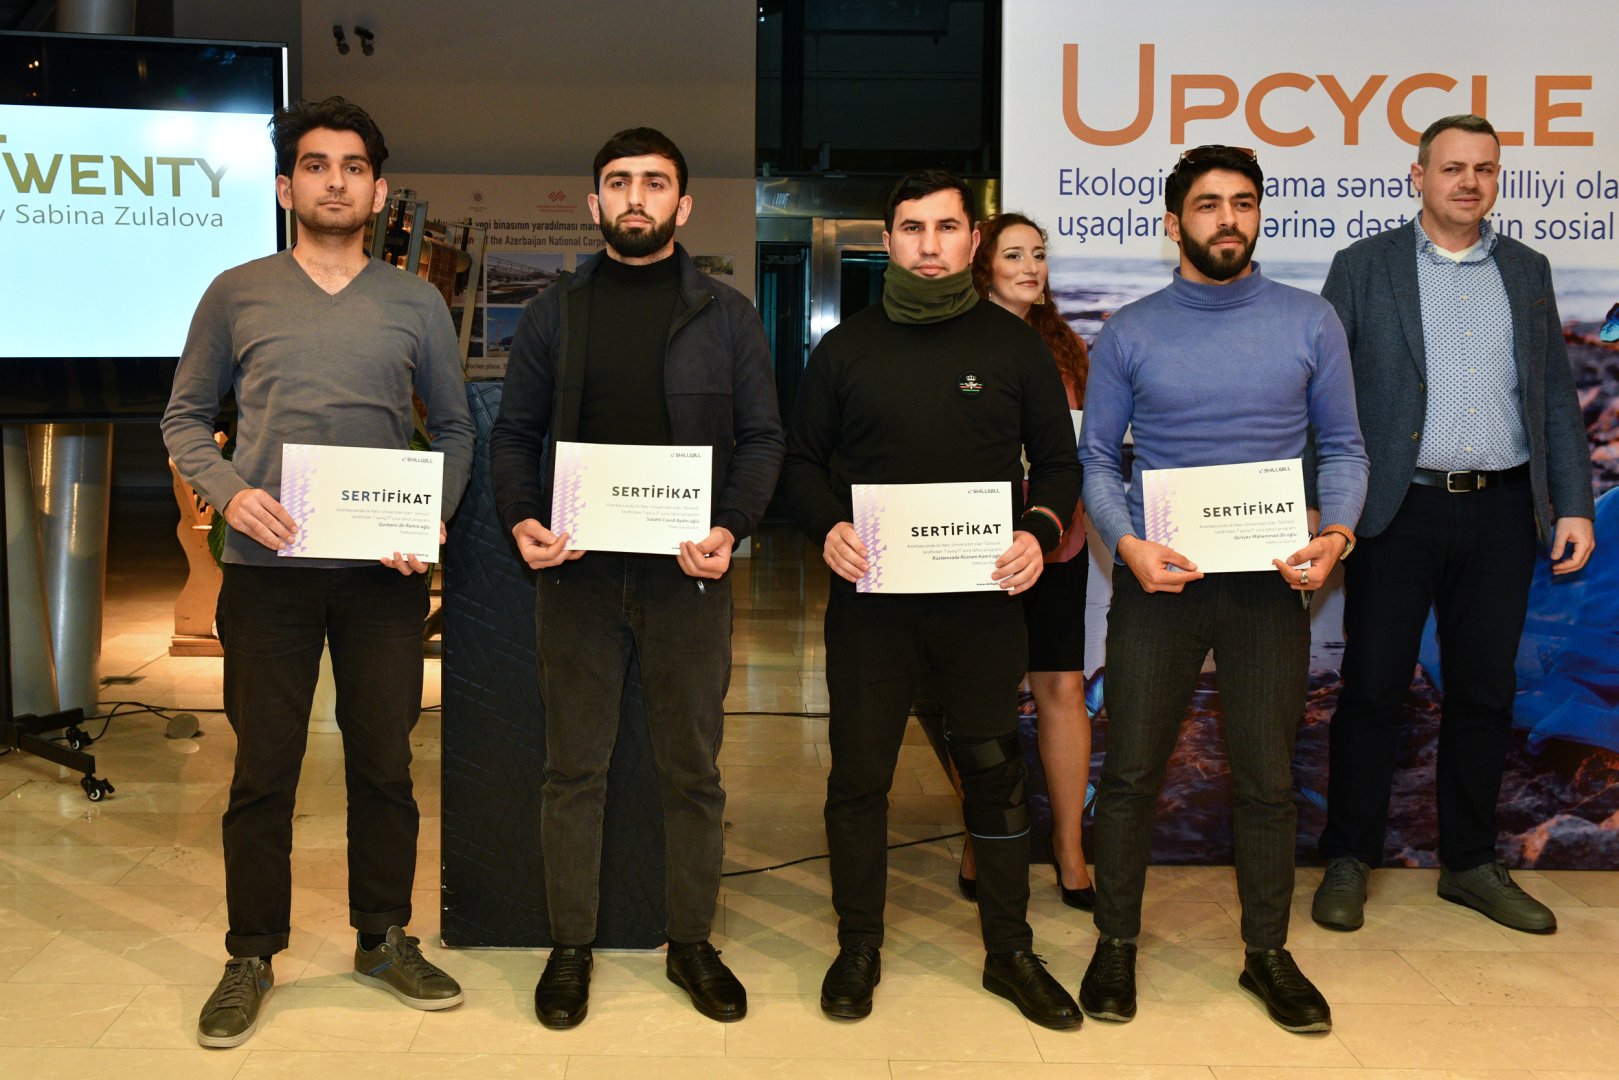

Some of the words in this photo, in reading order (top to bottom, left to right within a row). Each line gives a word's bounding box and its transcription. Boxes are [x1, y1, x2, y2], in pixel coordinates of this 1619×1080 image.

[1062, 43, 1594, 148] UPCYCLE
[0, 134, 228, 198] WENTY
[1058, 168, 1169, 204] Ekologi
[1264, 176, 1325, 198] ama
[1496, 170, 1565, 207] lilliyi
[1576, 170, 1619, 199] ola
[15, 204, 104, 225] Sabina
[114, 206, 223, 227] Zulalova
[1058, 208, 1168, 244] uşaqlar
[1257, 210, 1335, 238] ərinə
[1346, 210, 1408, 239] dəst
[1490, 212, 1523, 240] ün
[1534, 211, 1614, 239] sosial
[505, 235, 546, 248] Azerbaijan
[549, 236, 581, 246] National
[583, 237, 607, 248] Carpe
[341, 489, 432, 505] SERTİFİKAT
[611, 485, 701, 499] SERTİFİKAT
[1203, 501, 1295, 518] SERTİFİKAT
[911, 522, 1002, 537] SERTİFİKAT
